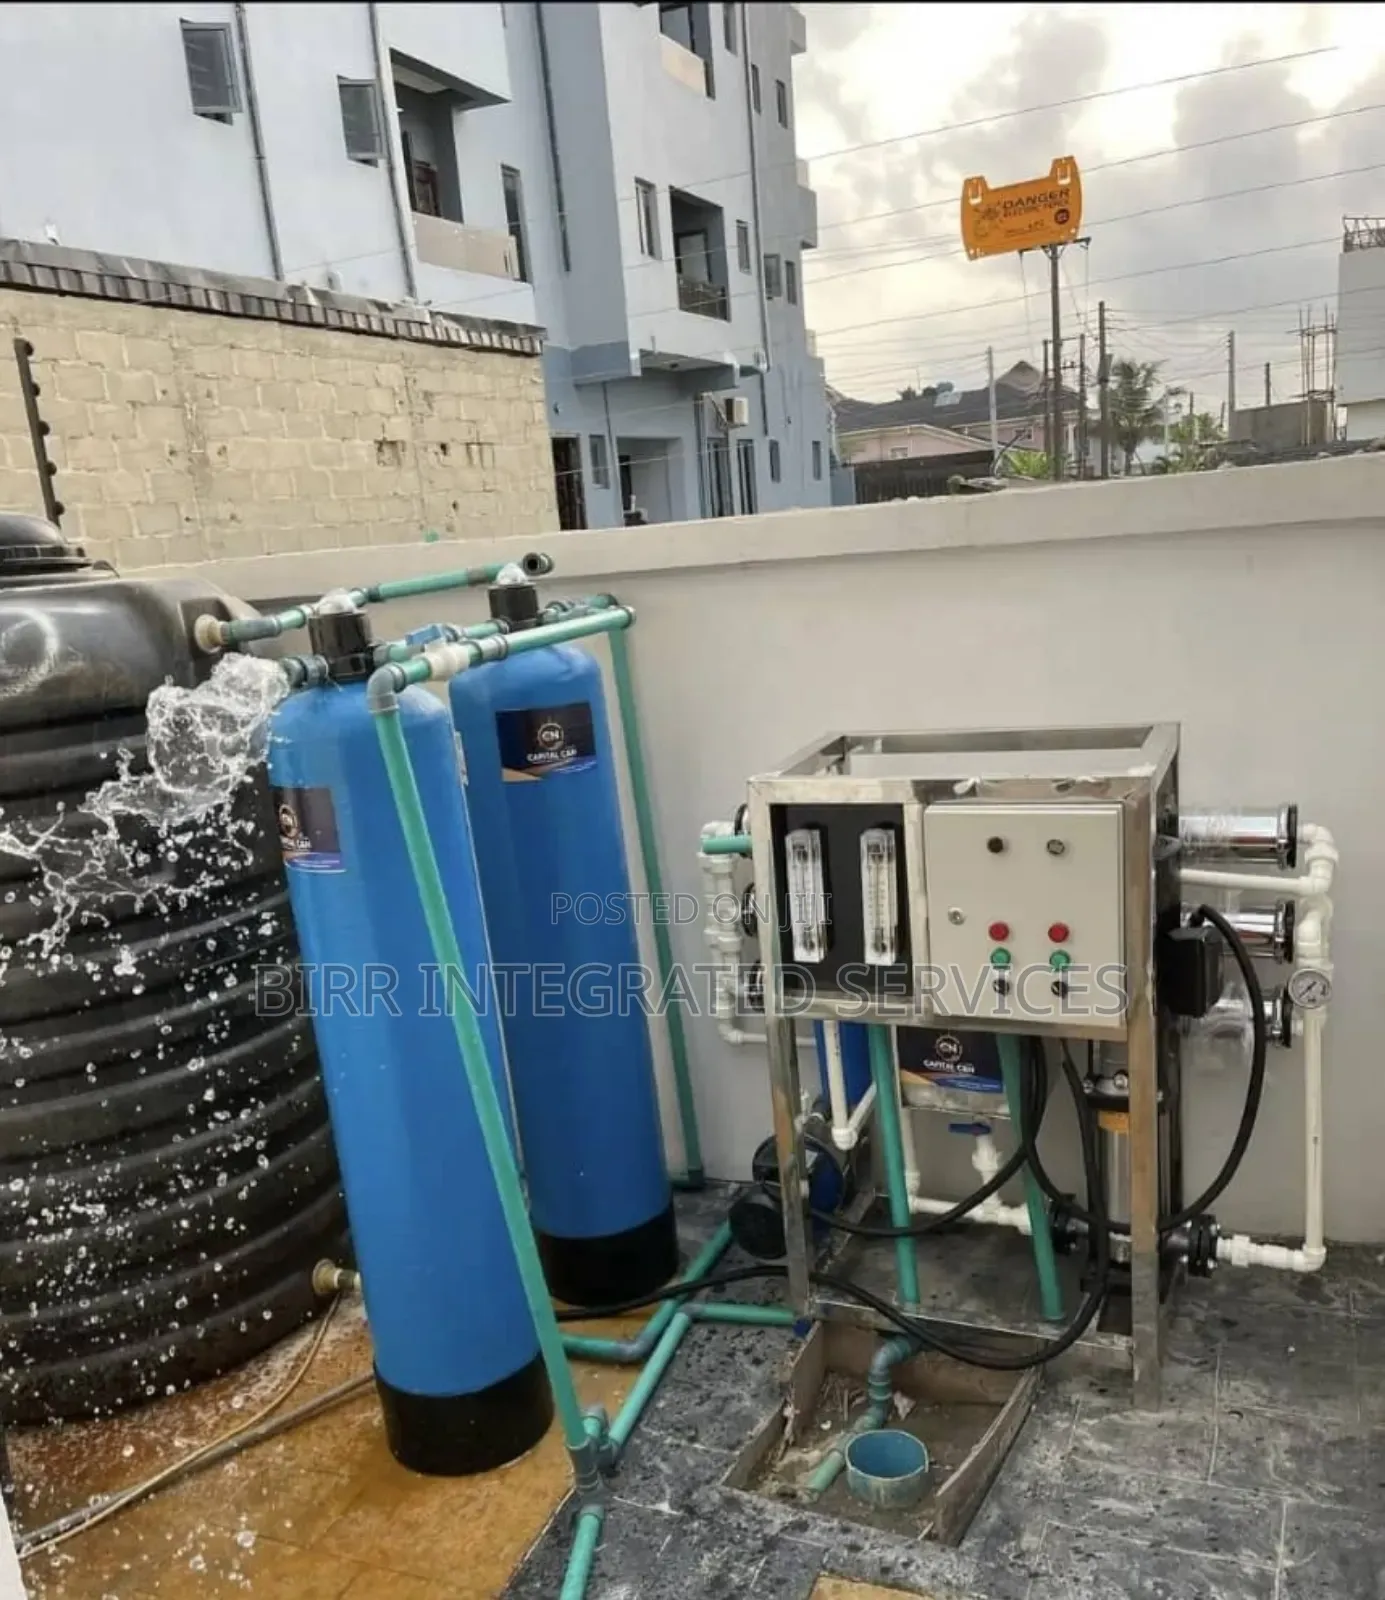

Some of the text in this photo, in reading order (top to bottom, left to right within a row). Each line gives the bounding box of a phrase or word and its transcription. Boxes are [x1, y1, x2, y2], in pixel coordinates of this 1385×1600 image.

[1003, 187, 1070, 209] DANGER
[526, 751, 559, 762] CAPITAL
[923, 1059, 954, 1071] CAPITAL
